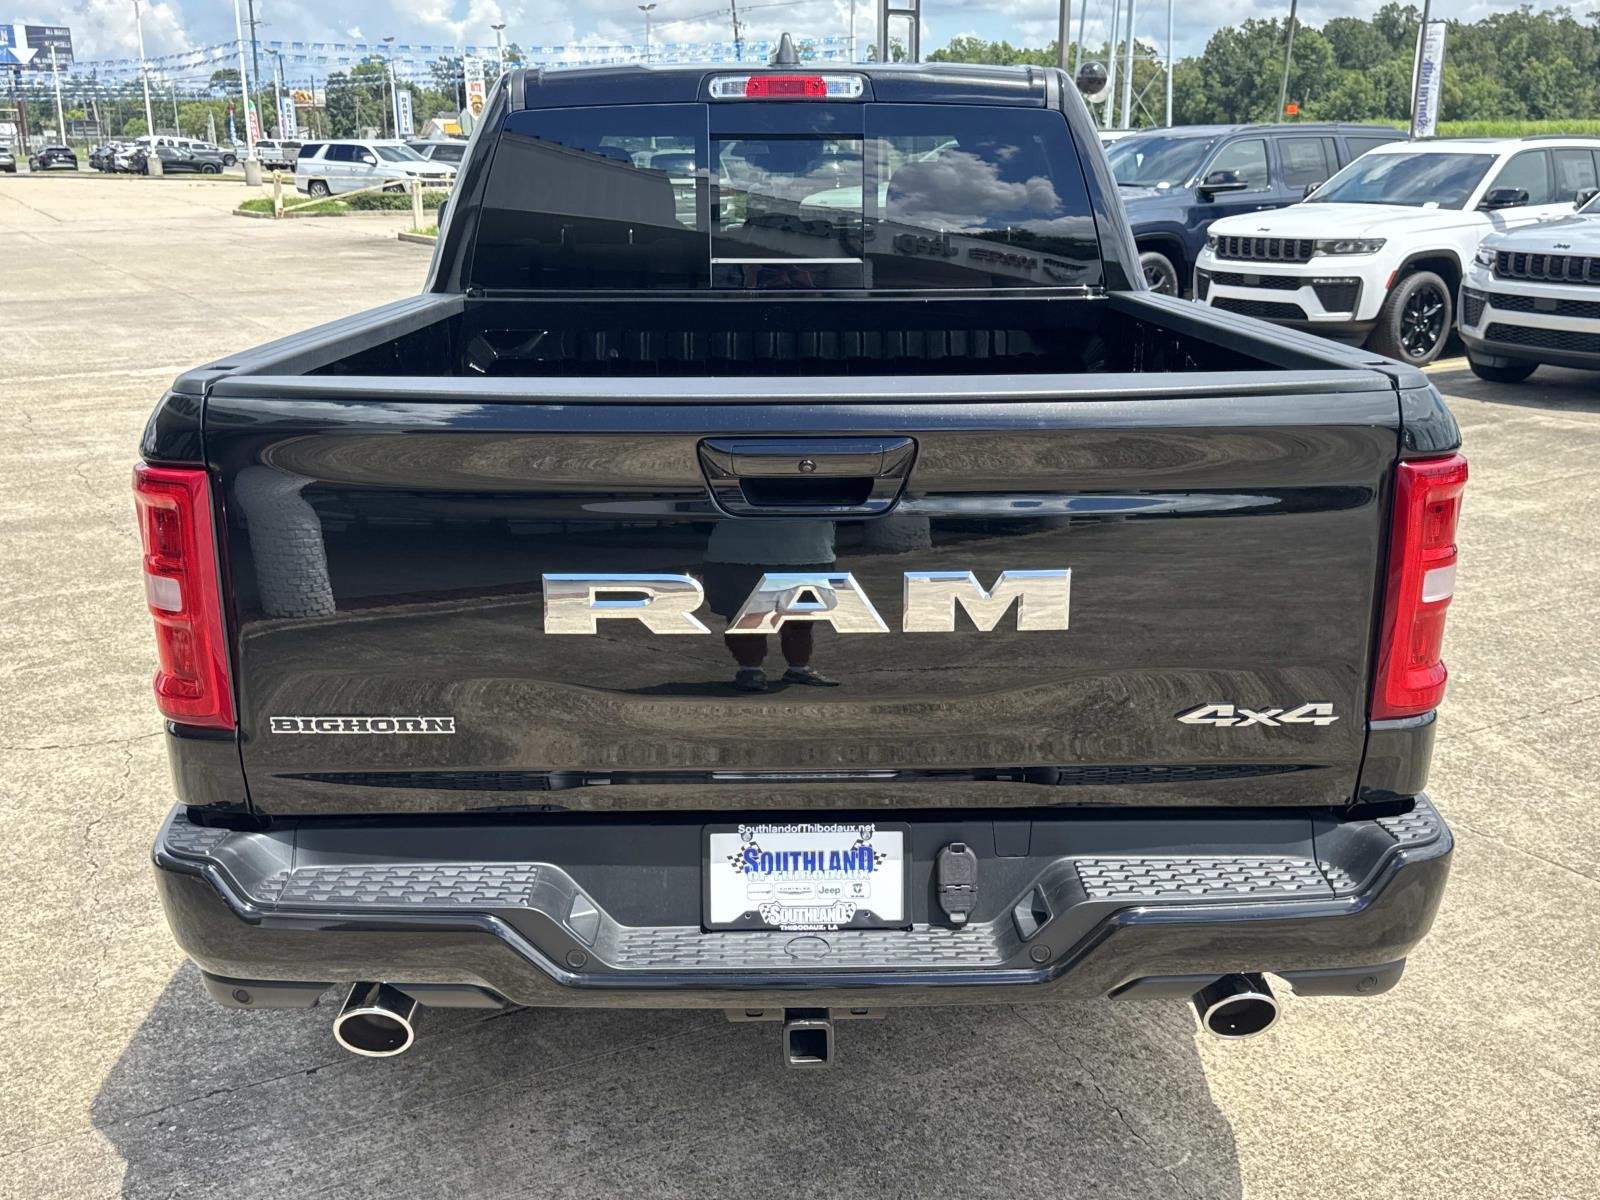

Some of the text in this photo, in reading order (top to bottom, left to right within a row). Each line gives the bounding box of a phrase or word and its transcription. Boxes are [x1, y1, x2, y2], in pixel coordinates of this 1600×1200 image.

[541, 568, 1073, 635] RAM
[1176, 702, 1340, 727] 4x4
[269, 716, 456, 734] BIGHORN
[738, 823, 876, 834] SouthlandofThibodaux.net
[744, 846, 874, 875] SOUTHLAND
[773, 869, 871, 881] THIBODAUX
[818, 885, 841, 895] Jeep
[769, 905, 847, 924] SOUTHLAND
